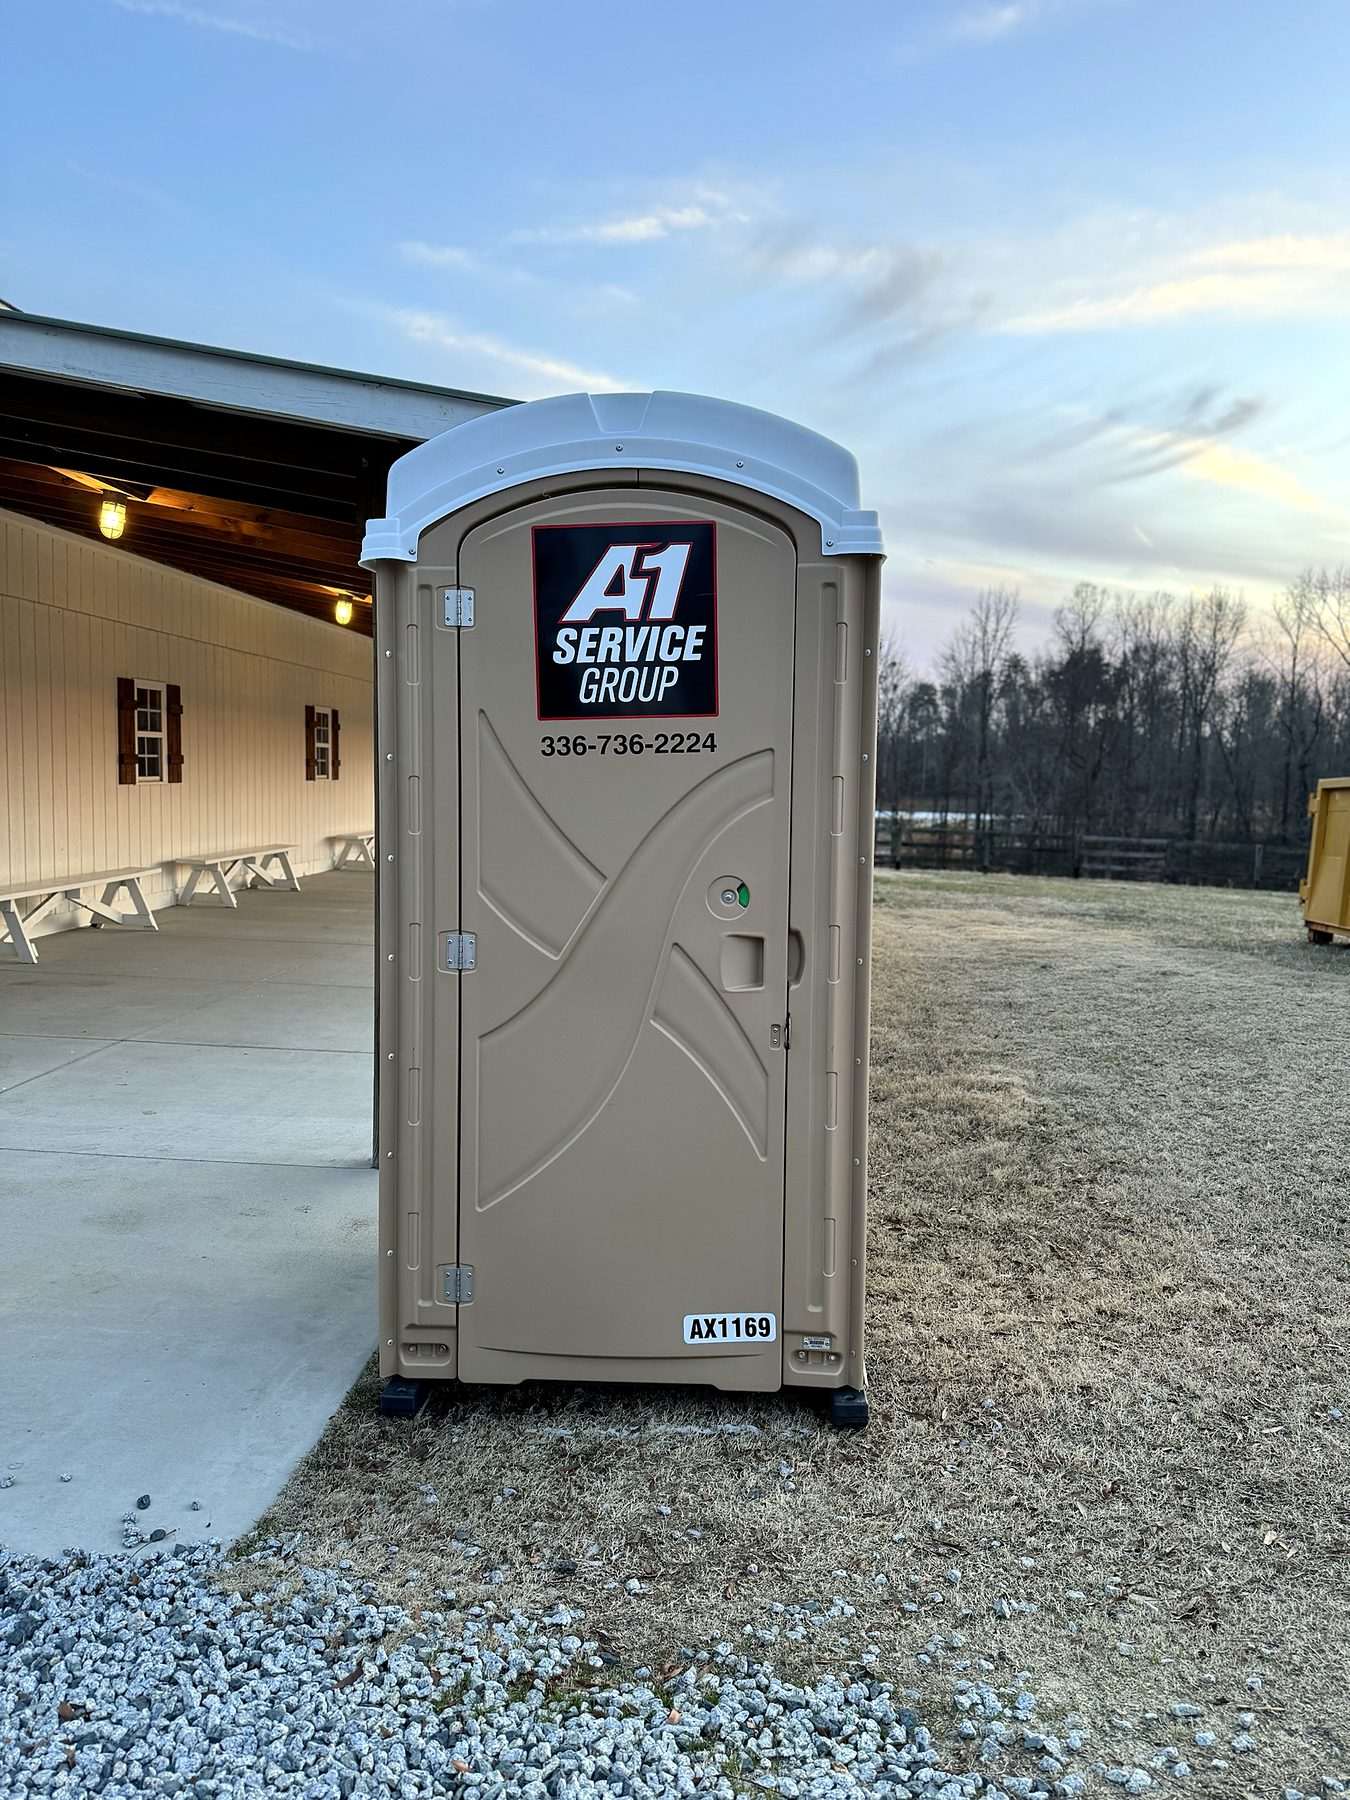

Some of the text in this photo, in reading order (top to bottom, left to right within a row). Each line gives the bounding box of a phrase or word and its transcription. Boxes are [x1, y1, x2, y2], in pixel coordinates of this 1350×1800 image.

[558, 541, 694, 623] A1
[552, 625, 707, 664] SERVICE
[579, 666, 679, 703] GROUP
[541, 733, 717, 756] 336-736-2224
[690, 1317, 771, 1339] AX1169
